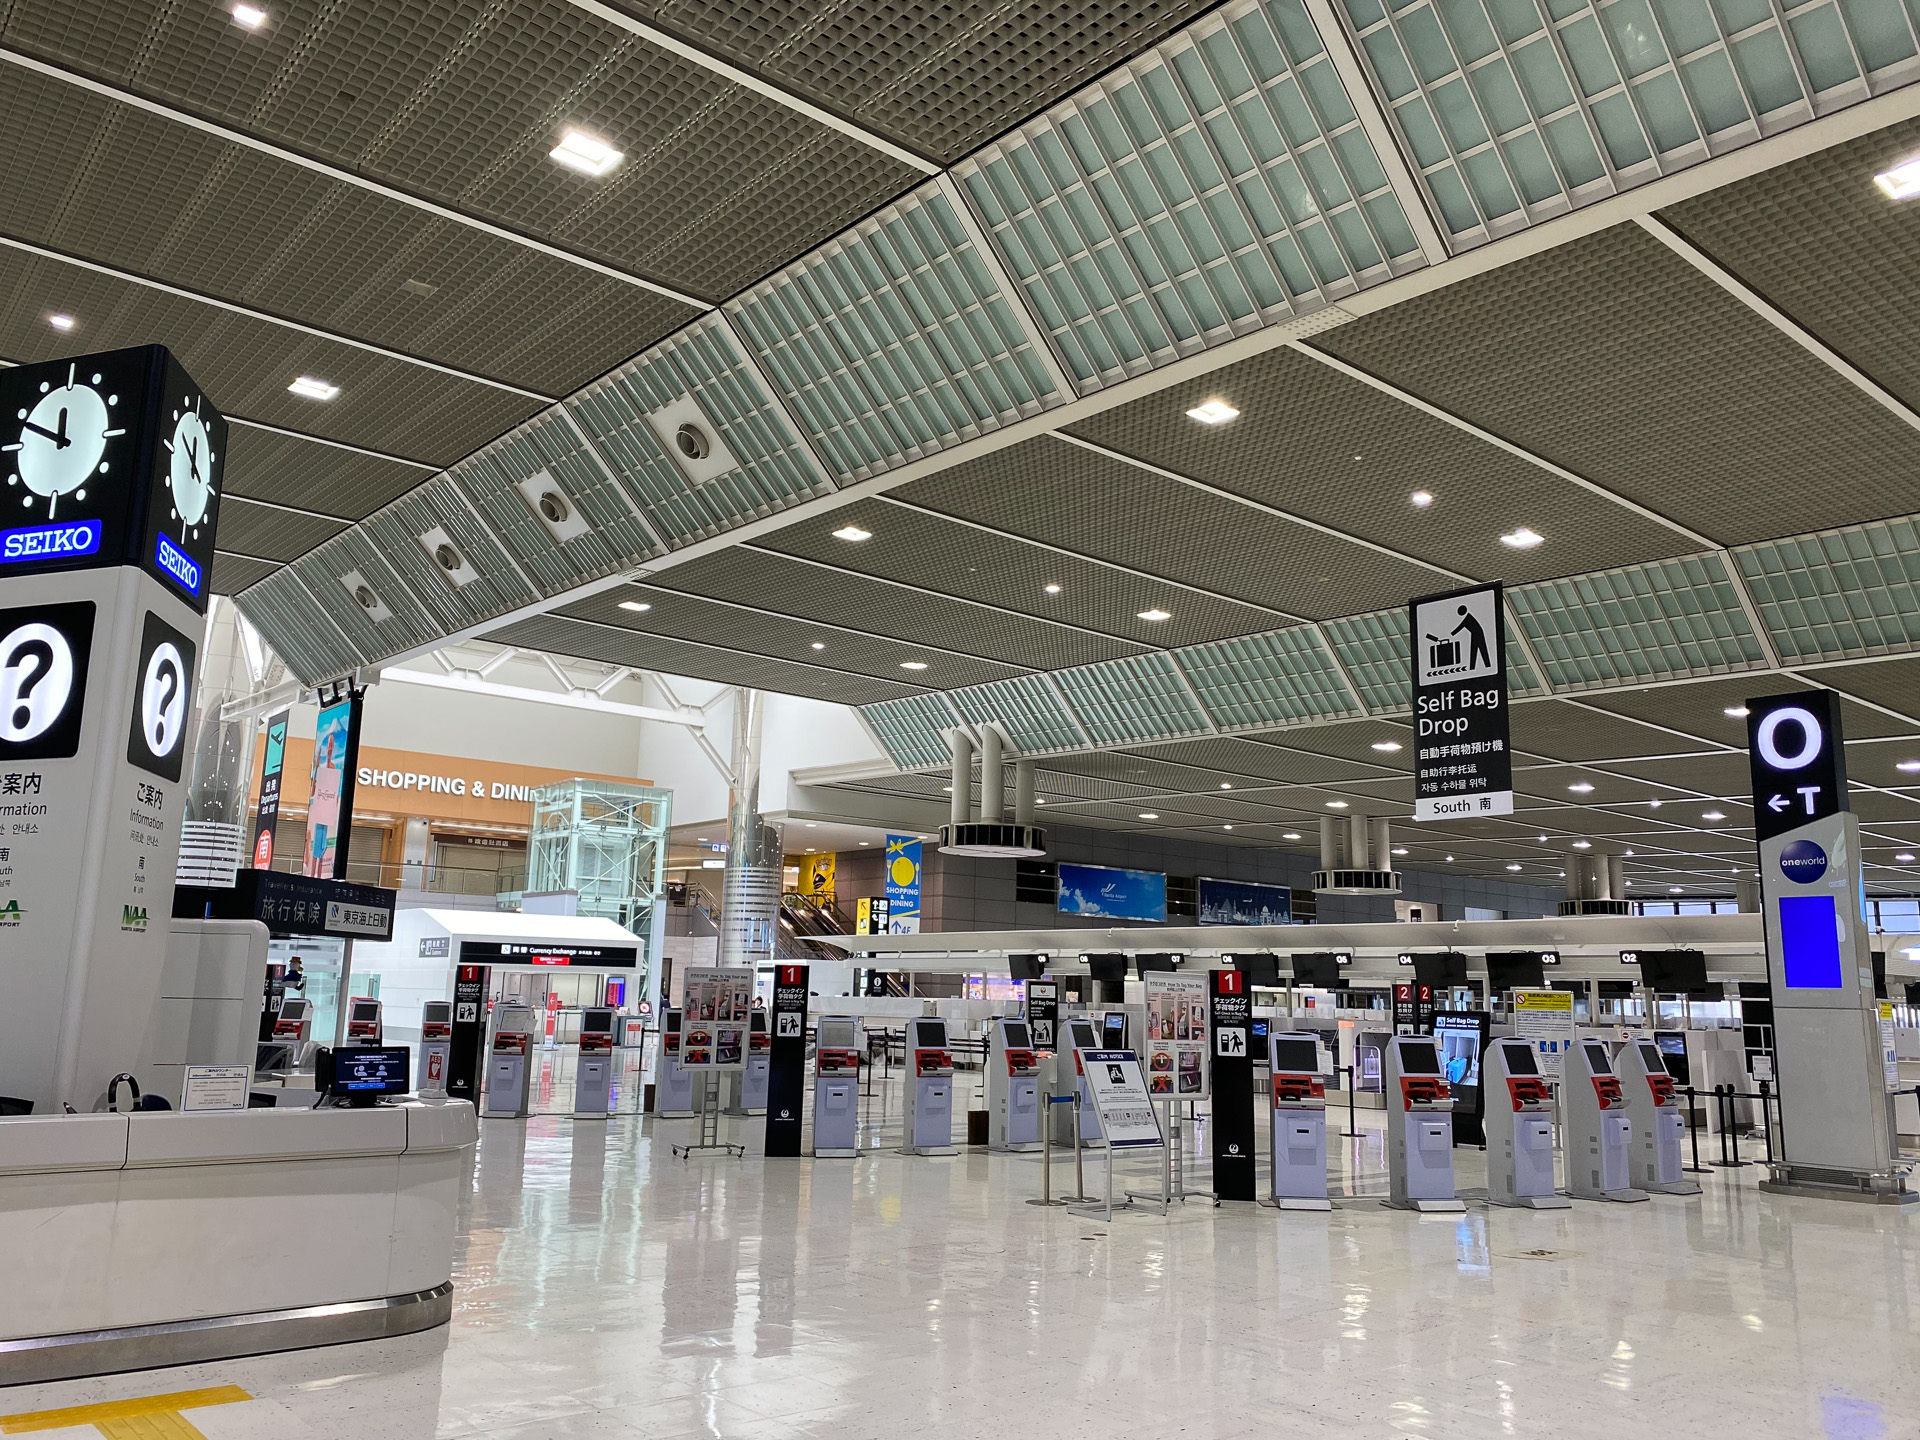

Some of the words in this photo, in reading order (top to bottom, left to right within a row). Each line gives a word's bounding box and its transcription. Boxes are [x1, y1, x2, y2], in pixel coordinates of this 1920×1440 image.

[4, 526, 93, 557] SEIKO
[158, 541, 198, 588] SEIKO
[1417, 690, 1455, 714] Self
[1460, 689, 1498, 709] Bag
[1419, 717, 1469, 737] Drop
[1758, 707, 1822, 770] O
[1420, 739, 1504, 760] 自動手荷物預け機
[1420, 763, 1477, 778] 自助行李托运
[0, 772, 42, 795] 案内
[357, 767, 465, 796] SHOPPING
[471, 781, 485, 797] &
[1421, 783, 1439, 792] 자동
[1441, 780, 1467, 791] 수하물
[1469, 777, 1487, 788] 위탁
[137, 782, 163, 810] ご案内
[1797, 786, 1821, 815] T
[0, 802, 47, 816] rmation
[1433, 800, 1471, 814] South
[1479, 797, 1491, 810] 南
[130, 808, 163, 831] Information
[12, 823, 39, 835] 안내소
[0, 848, 10, 861] 南
[259, 834, 270, 860] 南
[138, 856, 145, 870] 南
[1782, 856, 1825, 866] oneworld
[0, 866, 13, 875] uth
[134, 873, 145, 883] South
[886, 886, 919, 896] SHOPPING
[260, 896, 321, 924] 旅行保険
[890, 899, 914, 907] DINING
[122, 904, 150, 927] NAA
[343, 910, 387, 928] 東京海上日動
[901, 926, 911, 934] 4F
[529, 947, 552, 955] Currency
[1542, 954, 1556, 963] 03
[1622, 953, 1637, 962] 02
[1171, 955, 1181, 963] 07
[1336, 955, 1347, 964] 05
[1400, 955, 1412, 964] 04
[467, 967, 473, 979] 1
[787, 967, 794, 982] 1
[1224, 973, 1233, 991] 1
[1401, 986, 1408, 999] 2
[1422, 987, 1428, 999] 2
